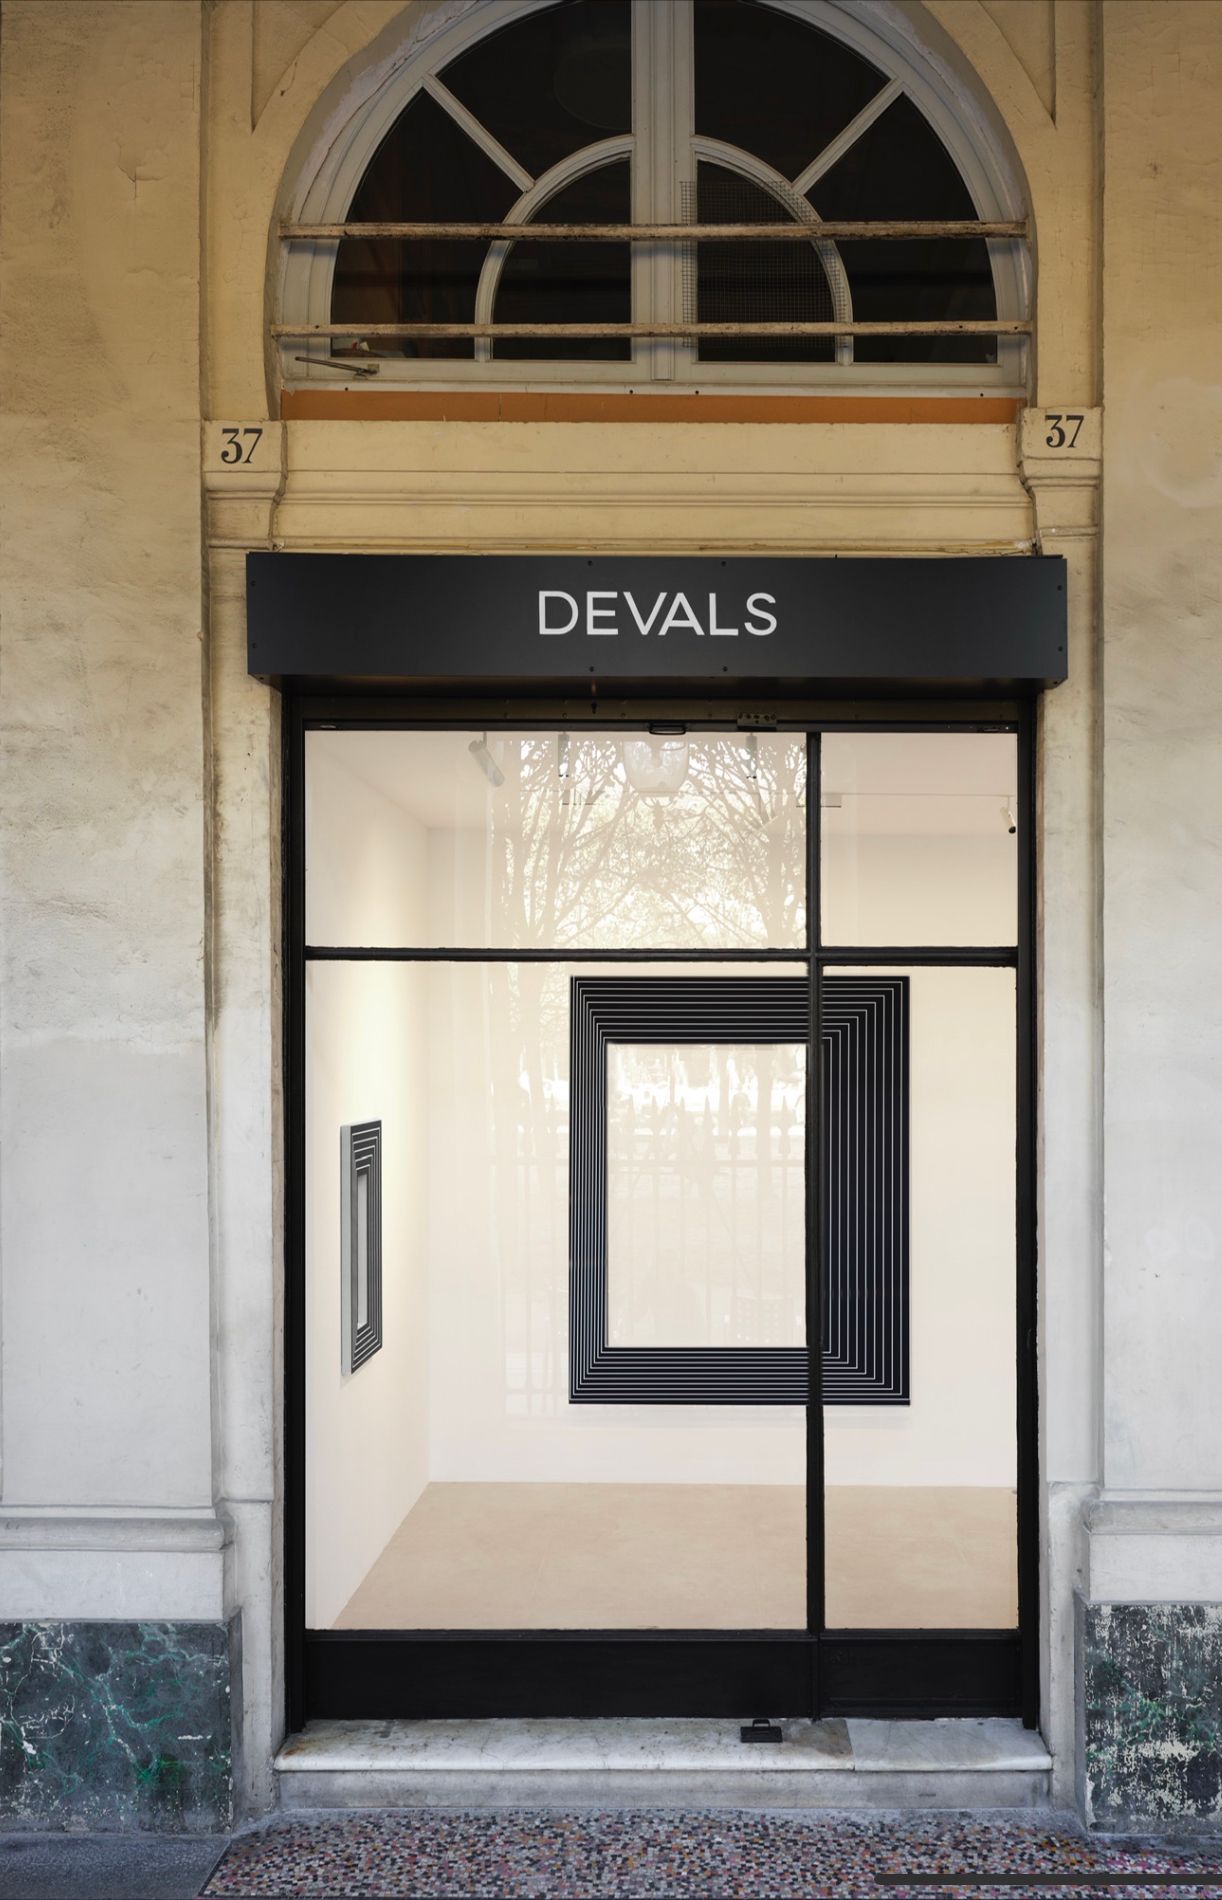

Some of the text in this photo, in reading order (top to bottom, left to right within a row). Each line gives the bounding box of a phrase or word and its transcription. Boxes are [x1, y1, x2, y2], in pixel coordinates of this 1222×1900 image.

[220, 428, 263, 464] 37
[1044, 414, 1085, 449] 37
[537, 590, 778, 636] DEVALS
